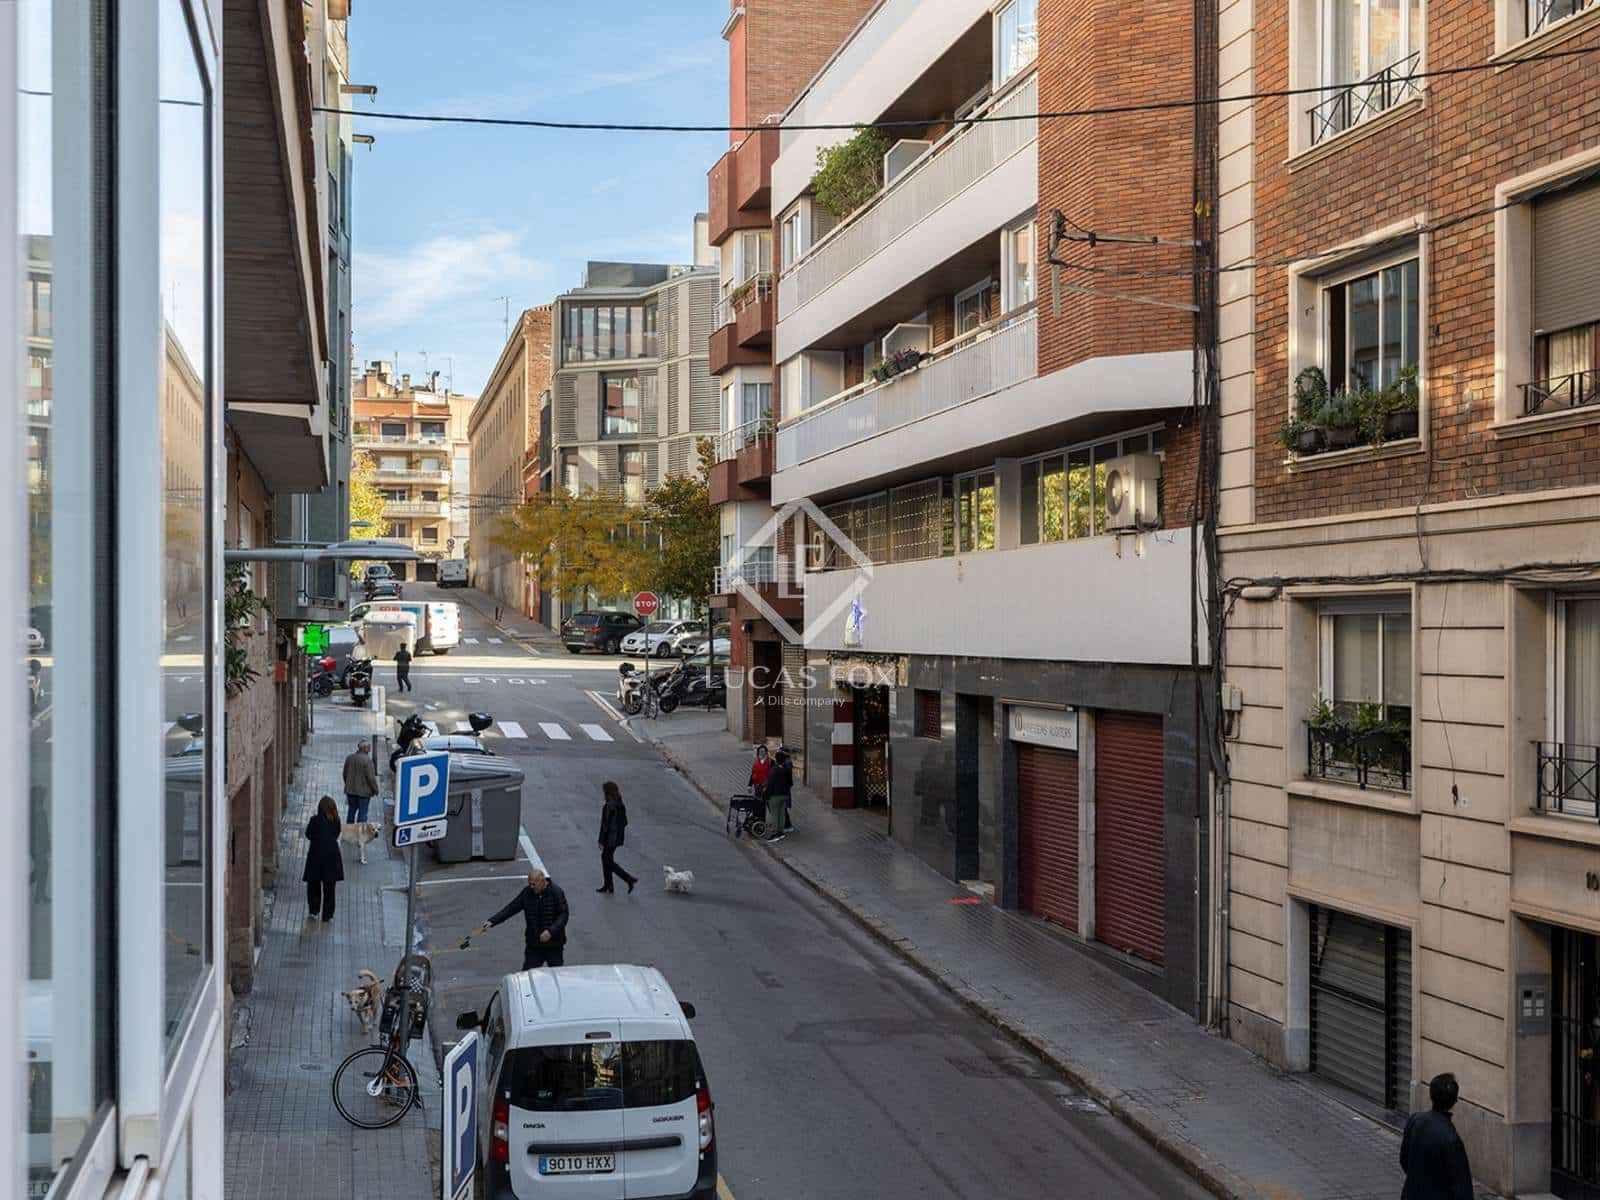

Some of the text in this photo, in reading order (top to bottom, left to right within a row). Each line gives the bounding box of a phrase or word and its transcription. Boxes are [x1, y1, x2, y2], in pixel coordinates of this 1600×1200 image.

[635, 600, 657, 609] STOP
[463, 677, 548, 685] STOP
[408, 763, 439, 815] P
[456, 1061, 473, 1175] P
[549, 1156, 611, 1171] 9010 HXX
